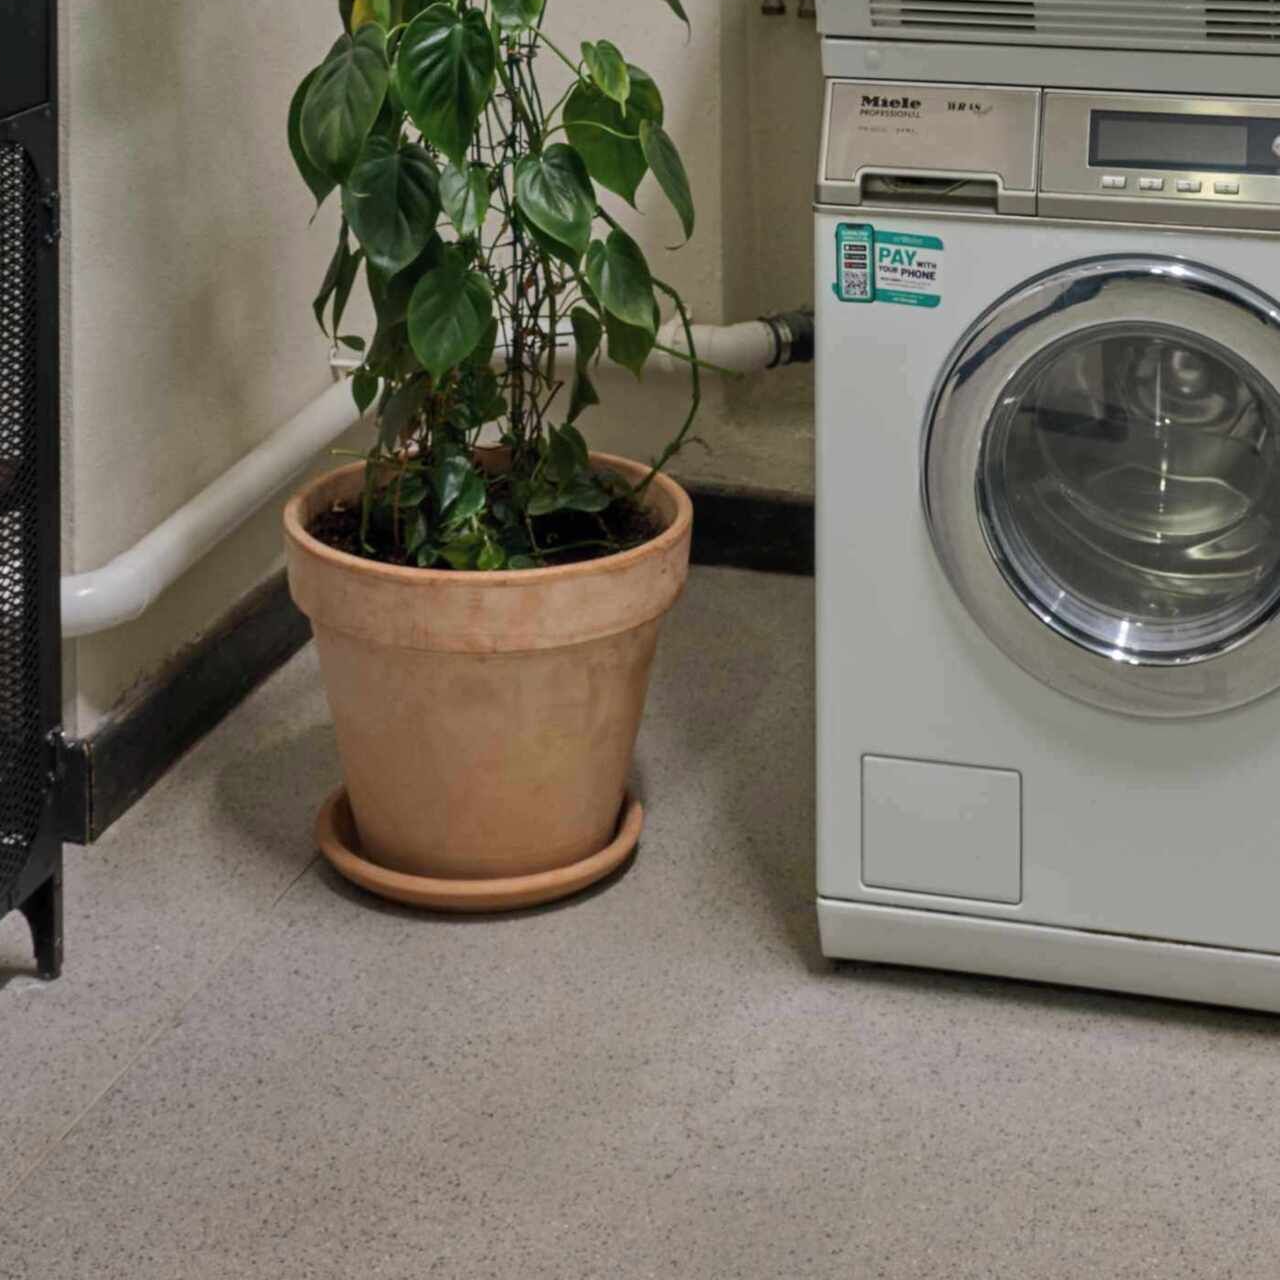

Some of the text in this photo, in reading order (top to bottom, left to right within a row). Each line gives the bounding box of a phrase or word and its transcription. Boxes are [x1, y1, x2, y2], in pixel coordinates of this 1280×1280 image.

[861, 95, 922, 109] Miele
[879, 247, 917, 266] PAY
[916, 261, 937, 270] WITH
[879, 265, 937, 281] YOUR PHONE
